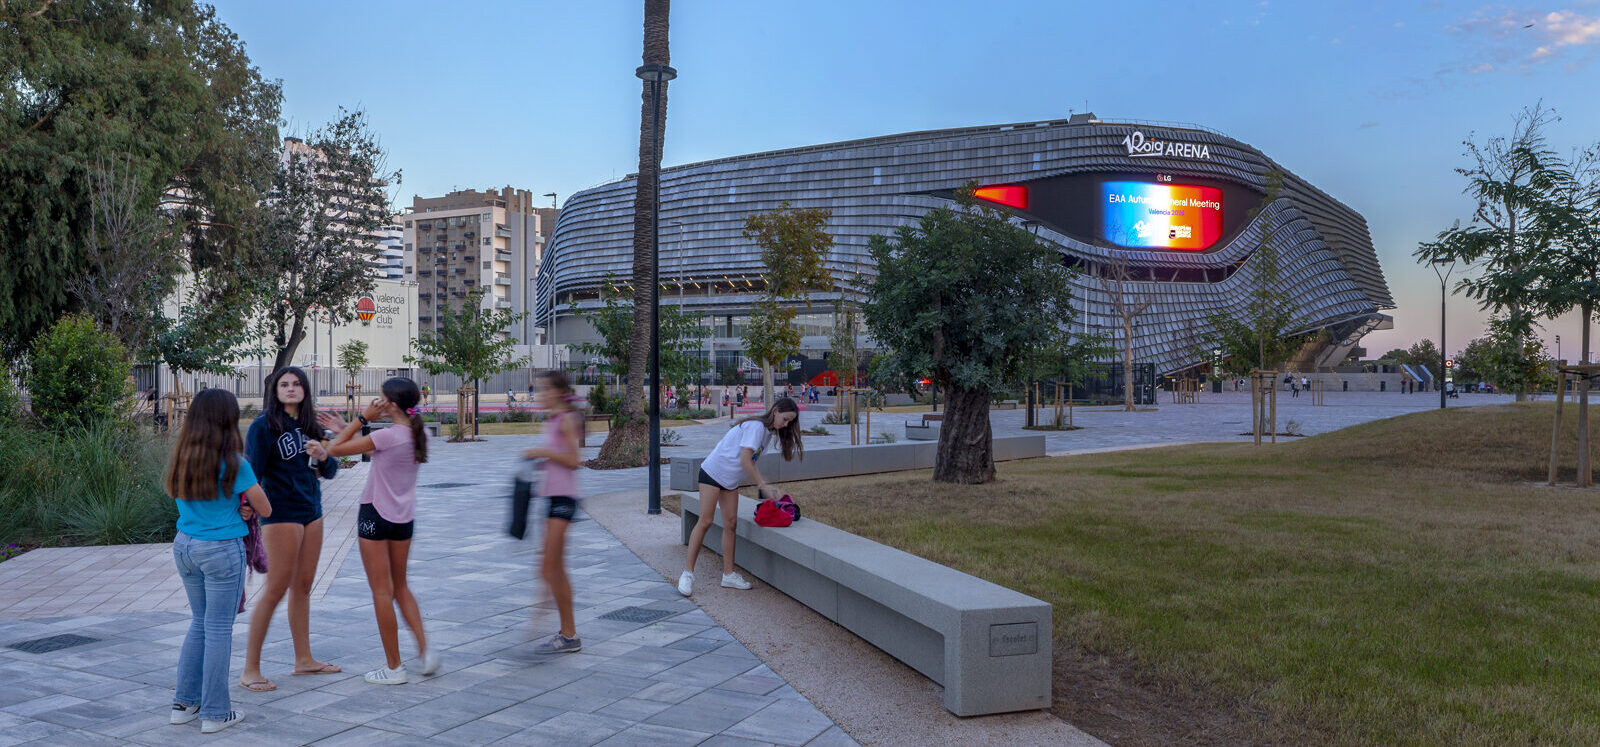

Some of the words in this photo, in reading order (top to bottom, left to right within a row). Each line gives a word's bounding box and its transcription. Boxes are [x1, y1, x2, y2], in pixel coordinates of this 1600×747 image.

[1121, 131, 1164, 157] Roig
[1164, 142, 1210, 159] ARENA
[1108, 193, 1126, 203] EAA
[1189, 198, 1220, 210] Meeting
[1148, 208, 1170, 216] Valencia
[376, 293, 405, 304] valencia
[376, 303, 400, 315] basket
[376, 315, 393, 325] club
